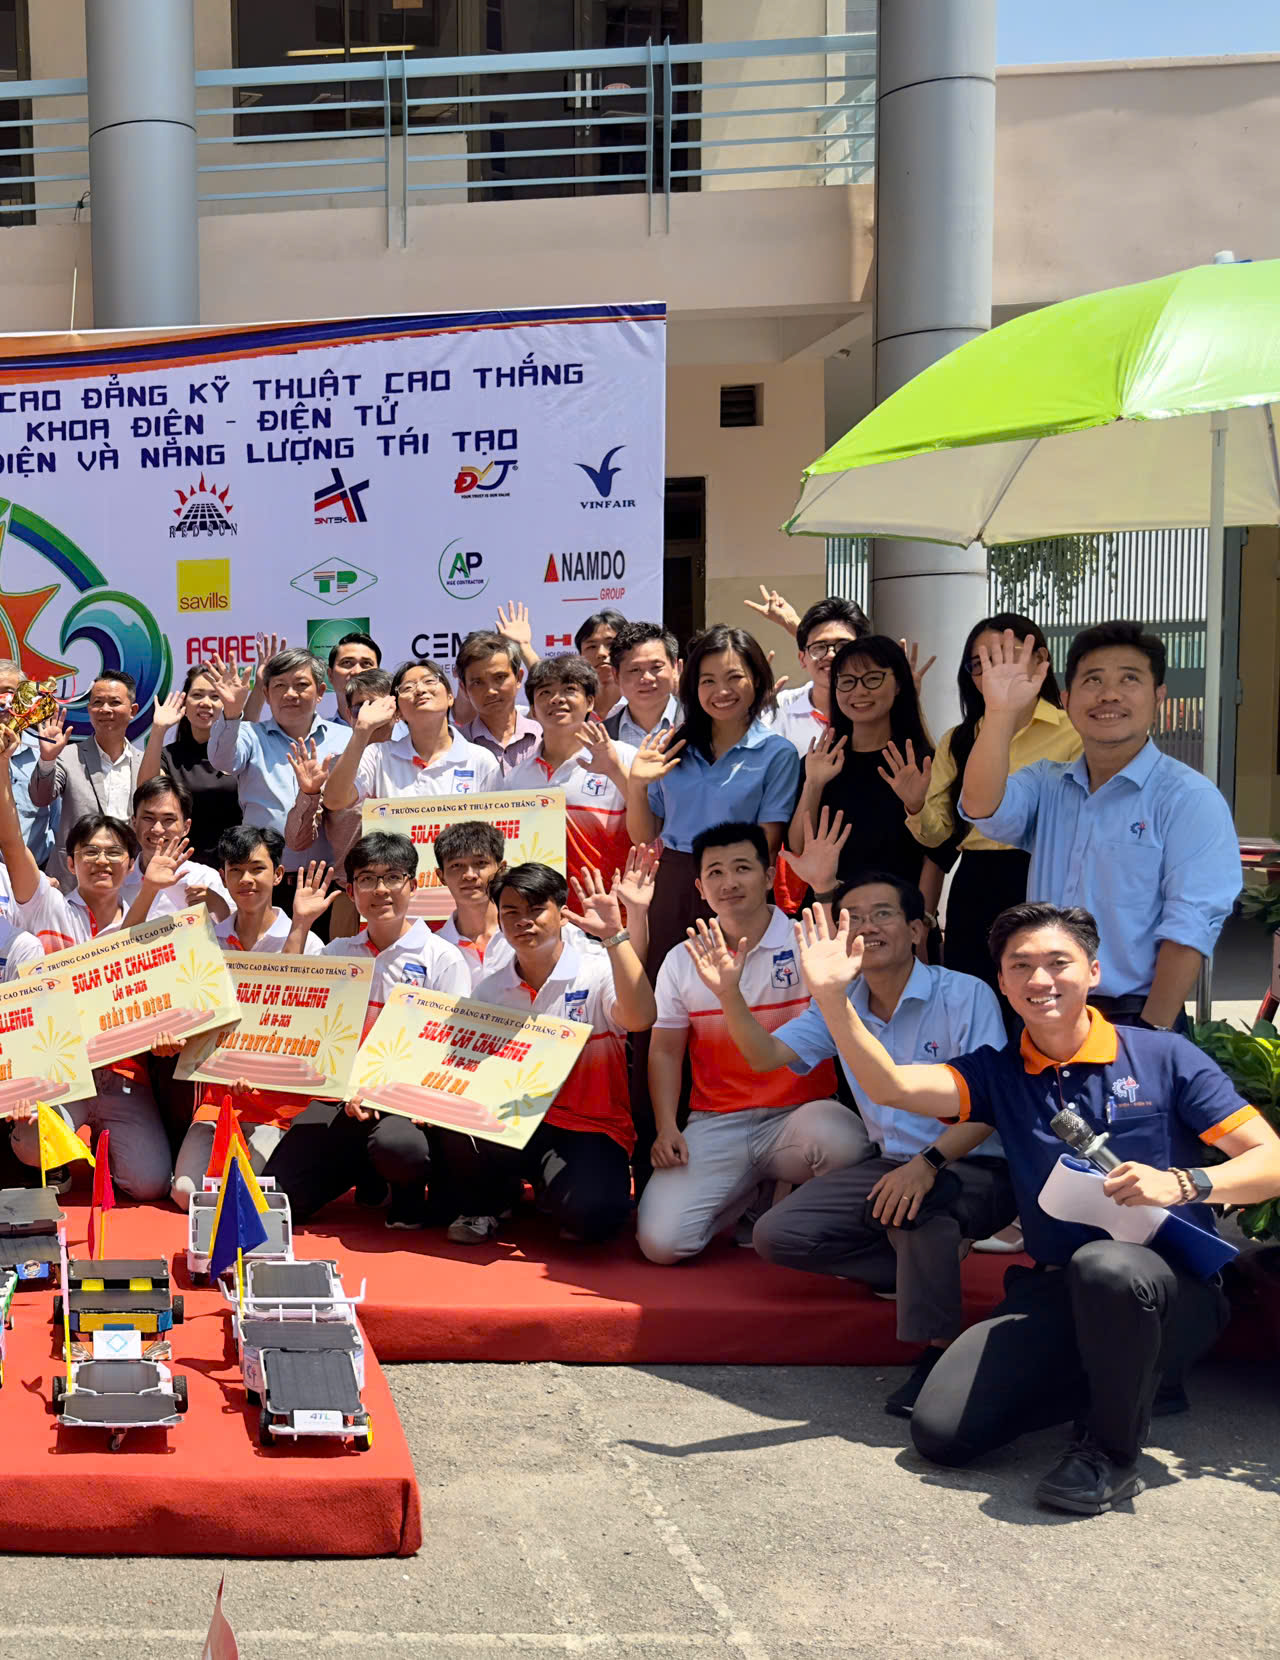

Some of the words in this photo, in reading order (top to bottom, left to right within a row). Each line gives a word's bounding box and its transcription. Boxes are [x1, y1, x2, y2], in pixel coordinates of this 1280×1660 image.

[81, 374, 168, 409] ĐẲNG
[189, 375, 231, 404] KỸ
[253, 369, 362, 402] THUẬT
[385, 369, 451, 394] CAO
[473, 352, 583, 389] THẮNG
[27, 418, 110, 442] KHOA
[130, 408, 204, 439] ĐIỆN
[257, 402, 332, 432] ĐIỆN
[354, 395, 398, 427] TỬ
[78, 442, 119, 472] VÀ
[246, 437, 355, 466] LƯỢNG
[377, 426, 429, 456] TÁI
[452, 428, 518, 456] TẠO
[580, 499, 636, 509] VINFAIR
[562, 550, 626, 582] NAMDO
[179, 592, 228, 610] savills
[600, 588, 625, 600] GROUP
[421, 805, 436, 813] CAO
[494, 801, 510, 809] CAO
[76, 952, 91, 963] CAO
[144, 929, 159, 940] CAO
[72, 967, 102, 995] SOLAR
[103, 961, 124, 984] CAR
[124, 942, 177, 976] CHALLENGE
[249, 963, 262, 971] CAO
[311, 967, 324, 975] CAO
[3, 991, 18, 1001] CAO
[236, 983, 263, 1004] SOLAR
[263, 984, 282, 1006] CAR
[282, 985, 330, 1009] CHALLENGE
[444, 1005, 459, 1014] CAO
[515, 1021, 531, 1029] CAO
[418, 1020, 454, 1044] SOLAR
[450, 1027, 475, 1049] CAR
[472, 1032, 532, 1063] CHALLENGE
